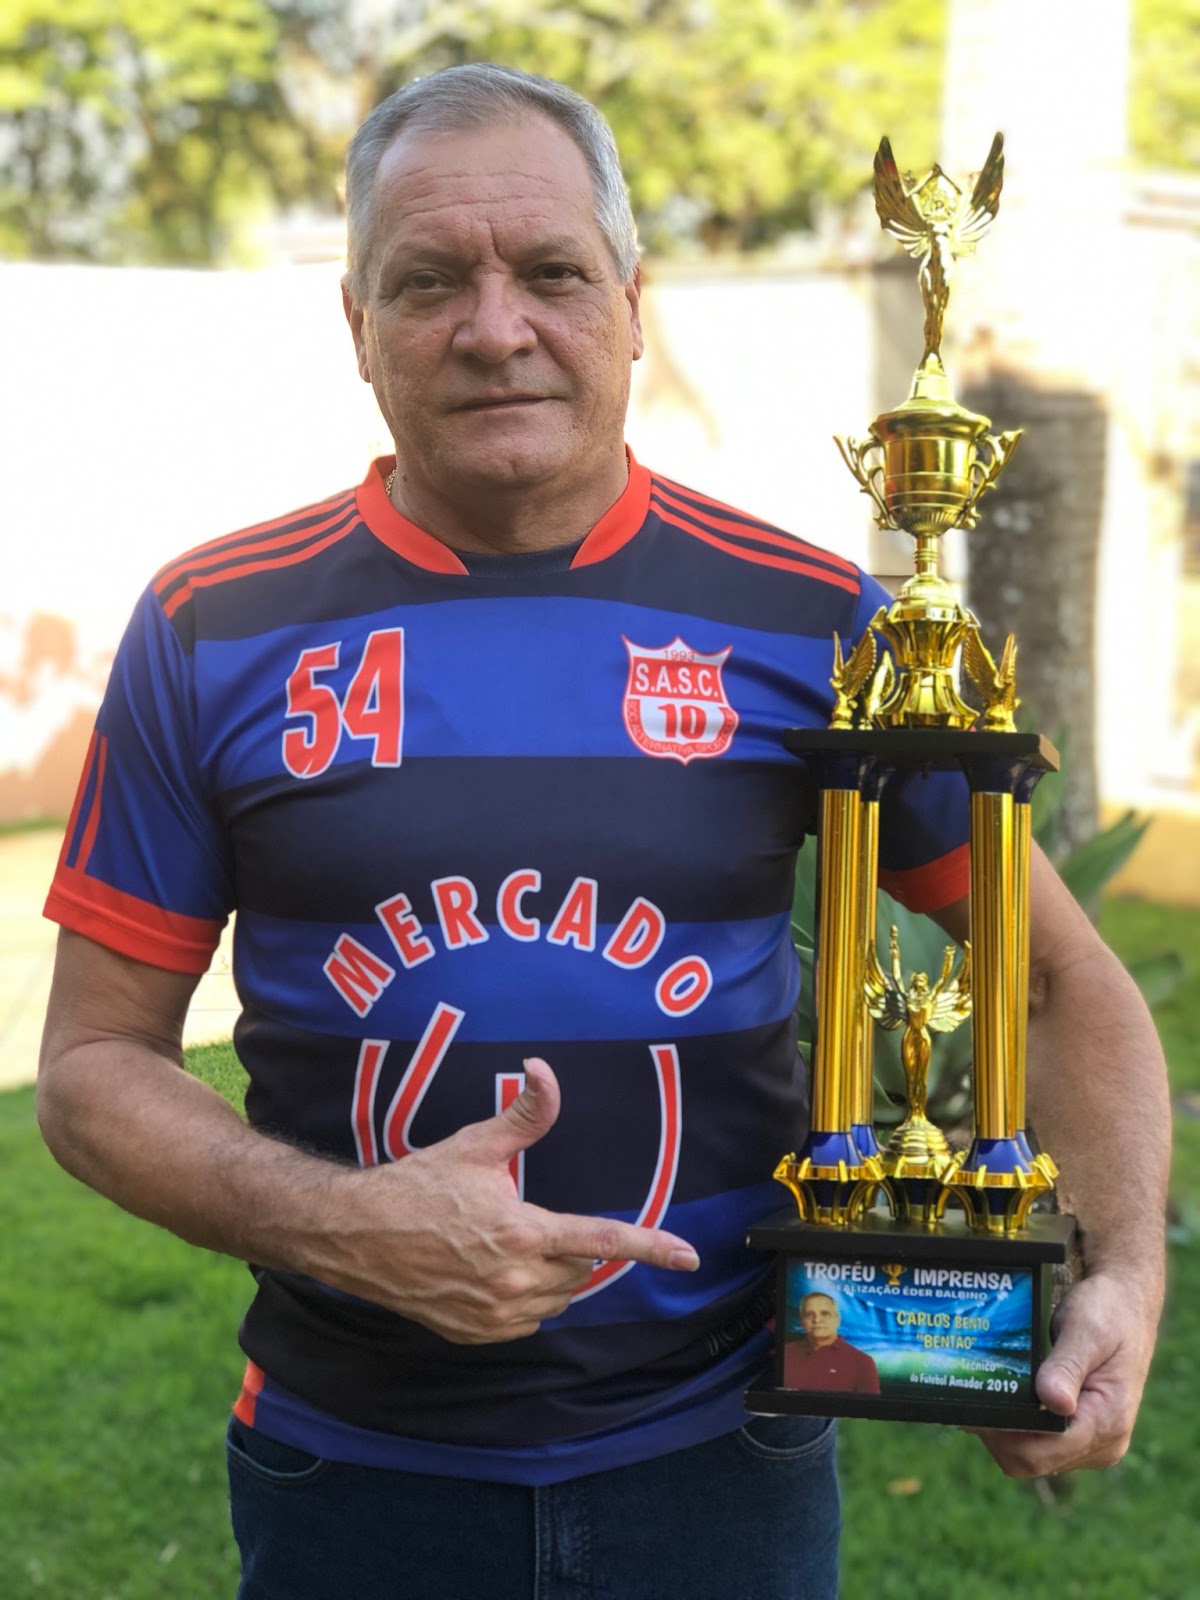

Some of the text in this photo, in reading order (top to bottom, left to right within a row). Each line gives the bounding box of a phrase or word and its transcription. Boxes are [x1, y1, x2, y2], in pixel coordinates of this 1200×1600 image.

[663, 650, 696, 662] 1993
[634, 662, 719, 698] S.A.S.C.
[281, 626, 405, 780] 54
[657, 703, 707, 740] 10
[322, 868, 714, 1019] MERCADO
[804, 1261, 1014, 1291] TROFÉU IMPRENSA
[827, 1284, 989, 1301] REALIZAÇÃO ÉDER BALBINO
[896, 1310, 991, 1332] CARLOS BENTO
[949, 1375, 984, 1390] Amador
[986, 1379, 1019, 1394] 2019
